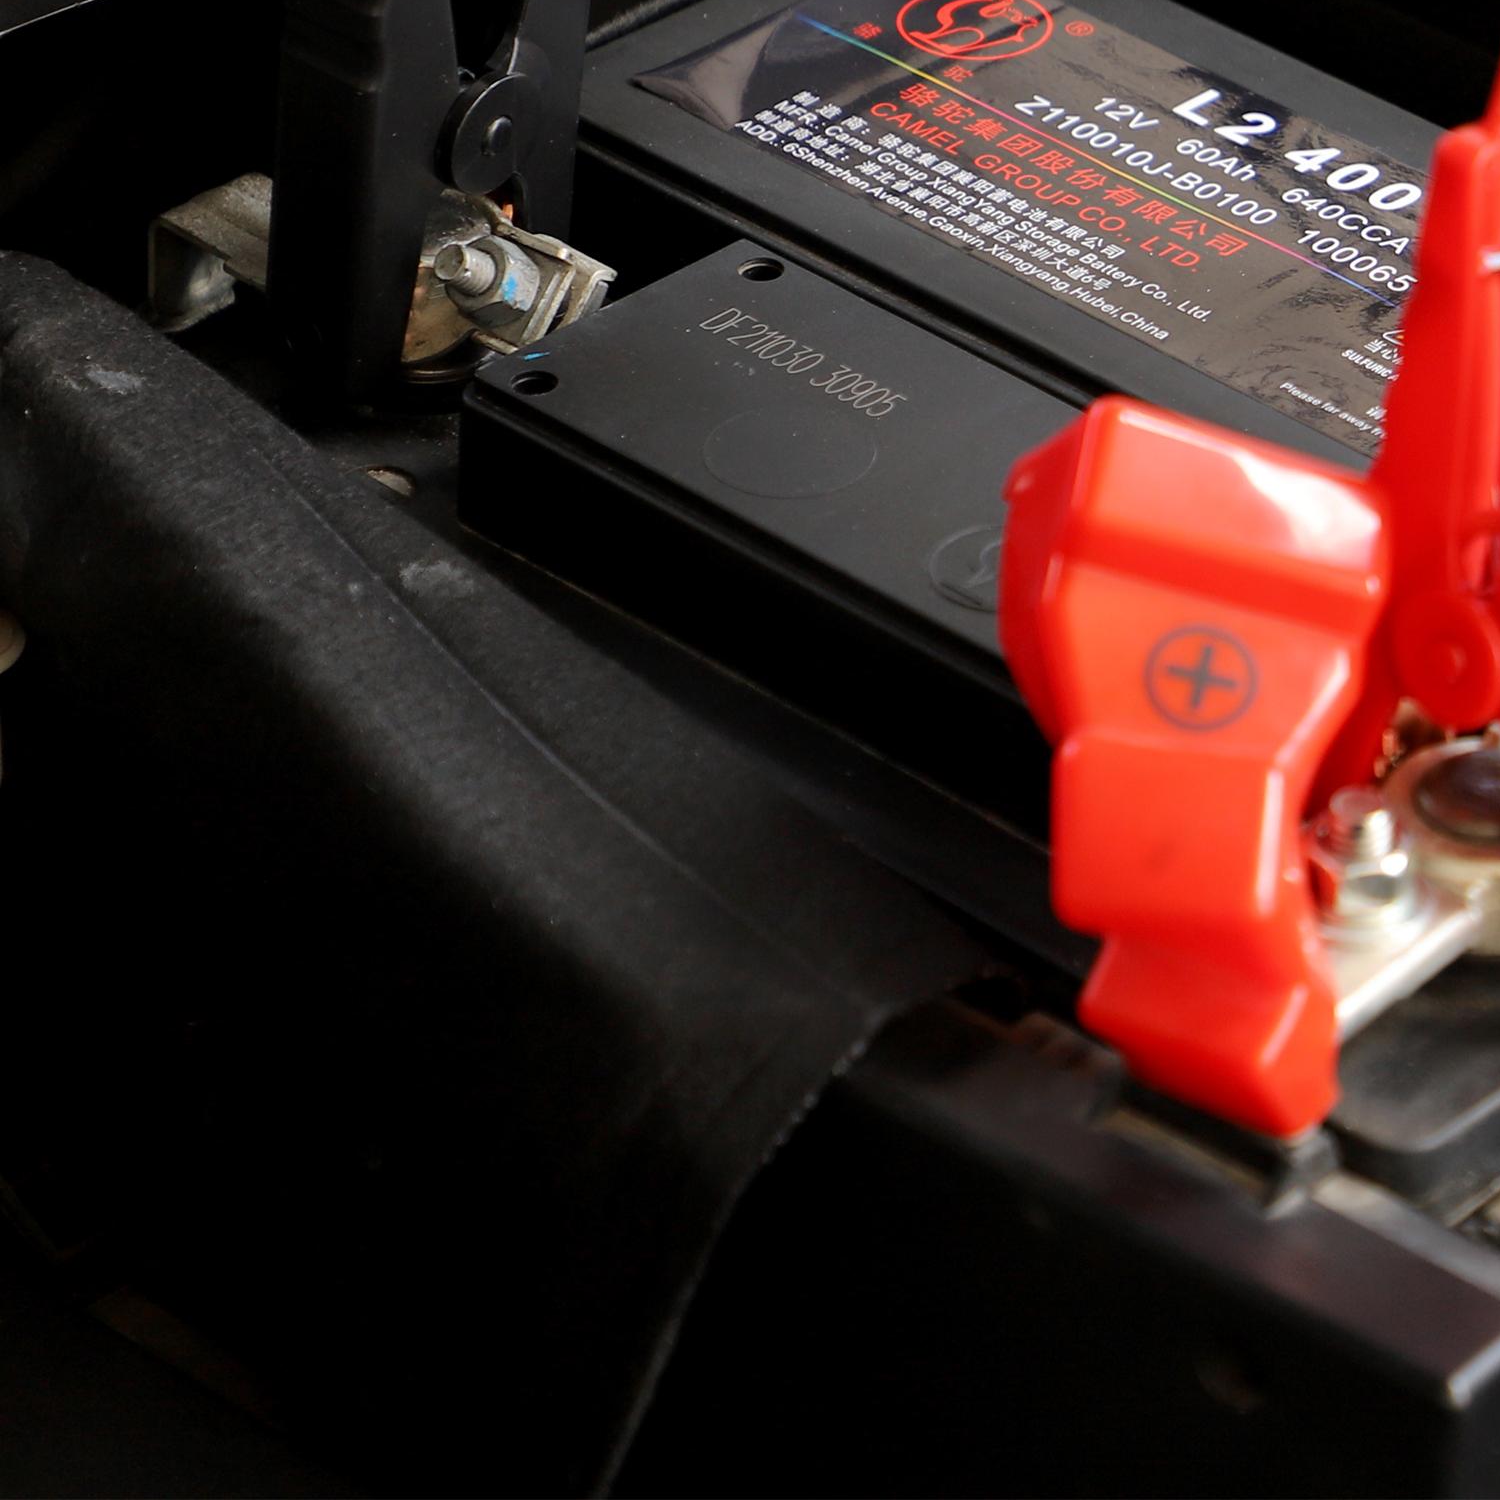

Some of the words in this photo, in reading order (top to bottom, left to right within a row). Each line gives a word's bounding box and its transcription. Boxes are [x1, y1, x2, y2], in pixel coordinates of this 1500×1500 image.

[825, 125, 876, 156] Camel
[877, 152, 928, 183] Group
[1015, 219, 1080, 258] Storage
[1079, 250, 1142, 290] Battery
[1177, 299, 1212, 322] Ltd.
[870, 101, 967, 156] CAMEL
[973, 153, 1081, 208] GROUP
[1139, 235, 1200, 273] LTD.
[900, 83, 1249, 257] 骆驼集团股份有限公司
[1014, 94, 1279, 226] Z110010J-B0100
[1297, 228, 1417, 293] 100065
[1093, 97, 1160, 131] 12V
[1176, 138, 1258, 182] 60Ah
[1281, 186, 1411, 257] 640CCA
[1283, 146, 1422, 211] 400
[809, 364, 908, 417] 30905
[1280, 382, 1321, 406] Please
[1321, 402, 1340, 415] far
[1338, 411, 1372, 432] away
[1341, 349, 1394, 378] SULFURIC
